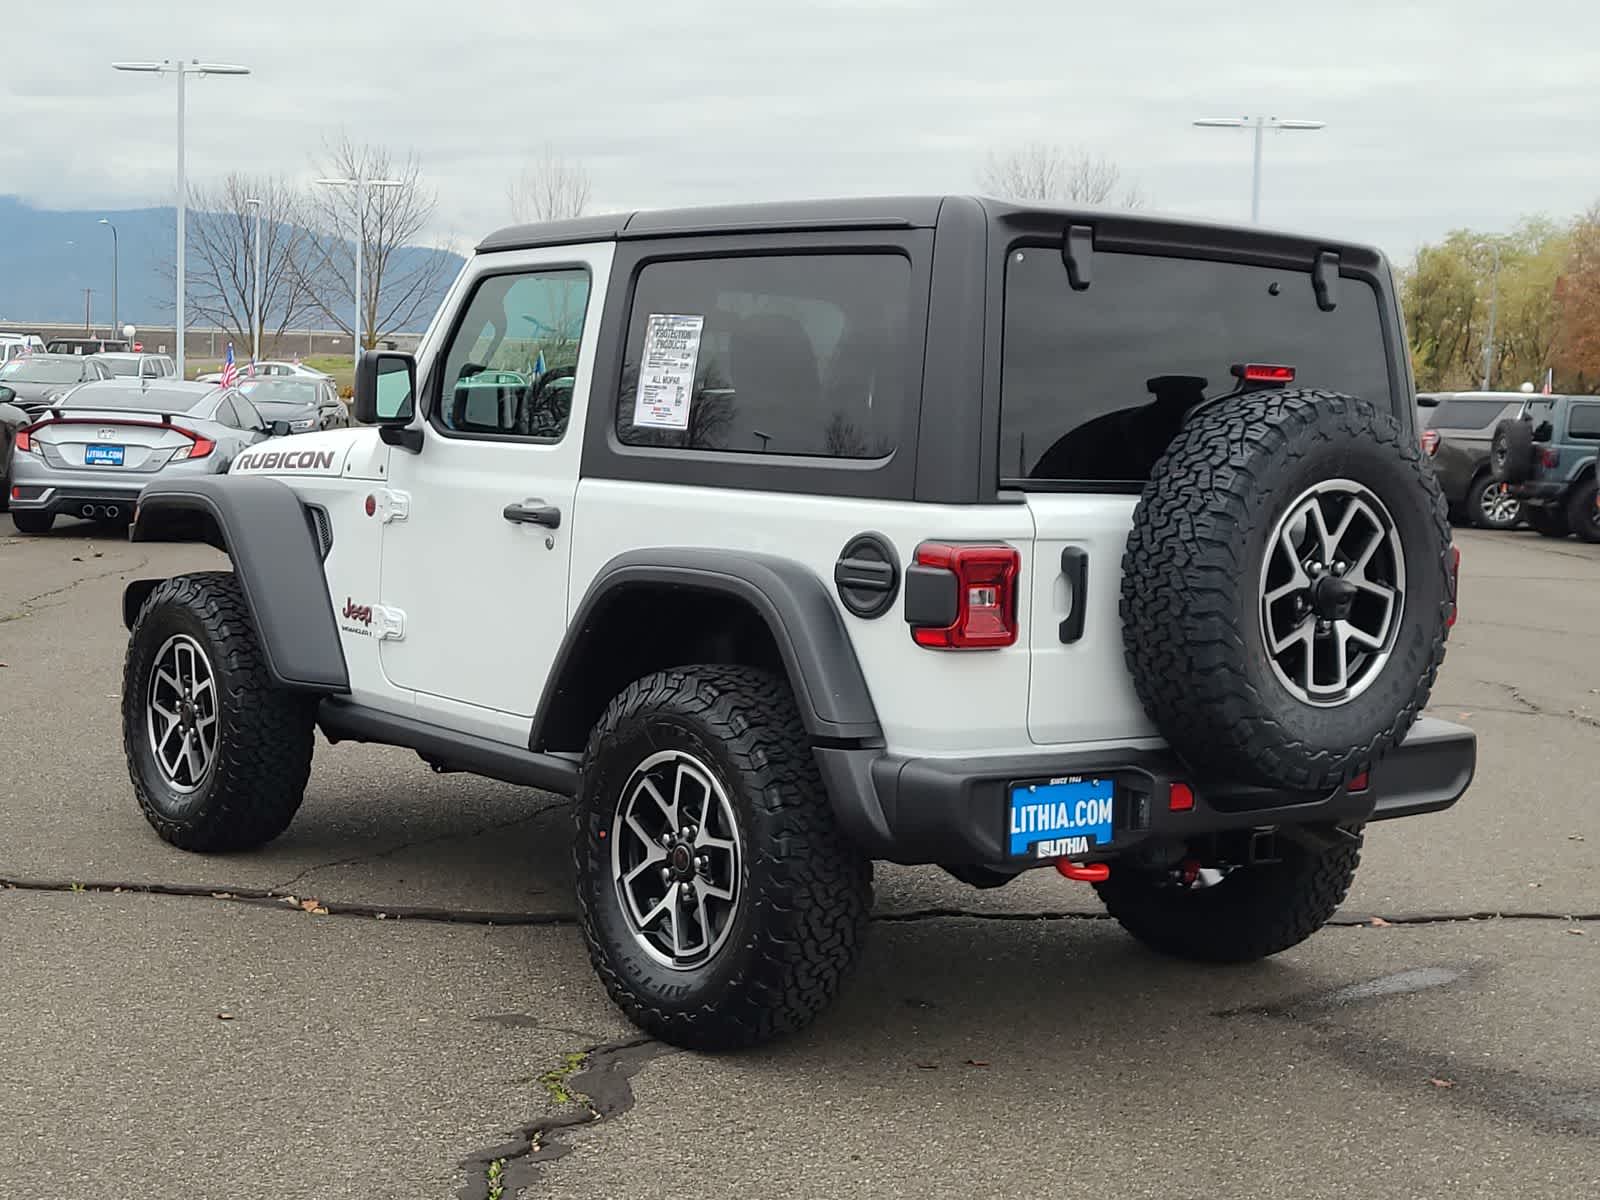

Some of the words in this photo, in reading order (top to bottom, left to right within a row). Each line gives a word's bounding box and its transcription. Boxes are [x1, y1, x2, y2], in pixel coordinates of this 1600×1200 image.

[655, 328, 692, 340] PROTECTION
[655, 339, 688, 350] PRODUCTS
[236, 450, 336, 470] RUBICON
[342, 597, 373, 627] Jeep
[1049, 777, 1068, 786] SINCE
[1010, 797, 1113, 834] LITHIA.COM
[1049, 836, 1089, 856] LITHIA
